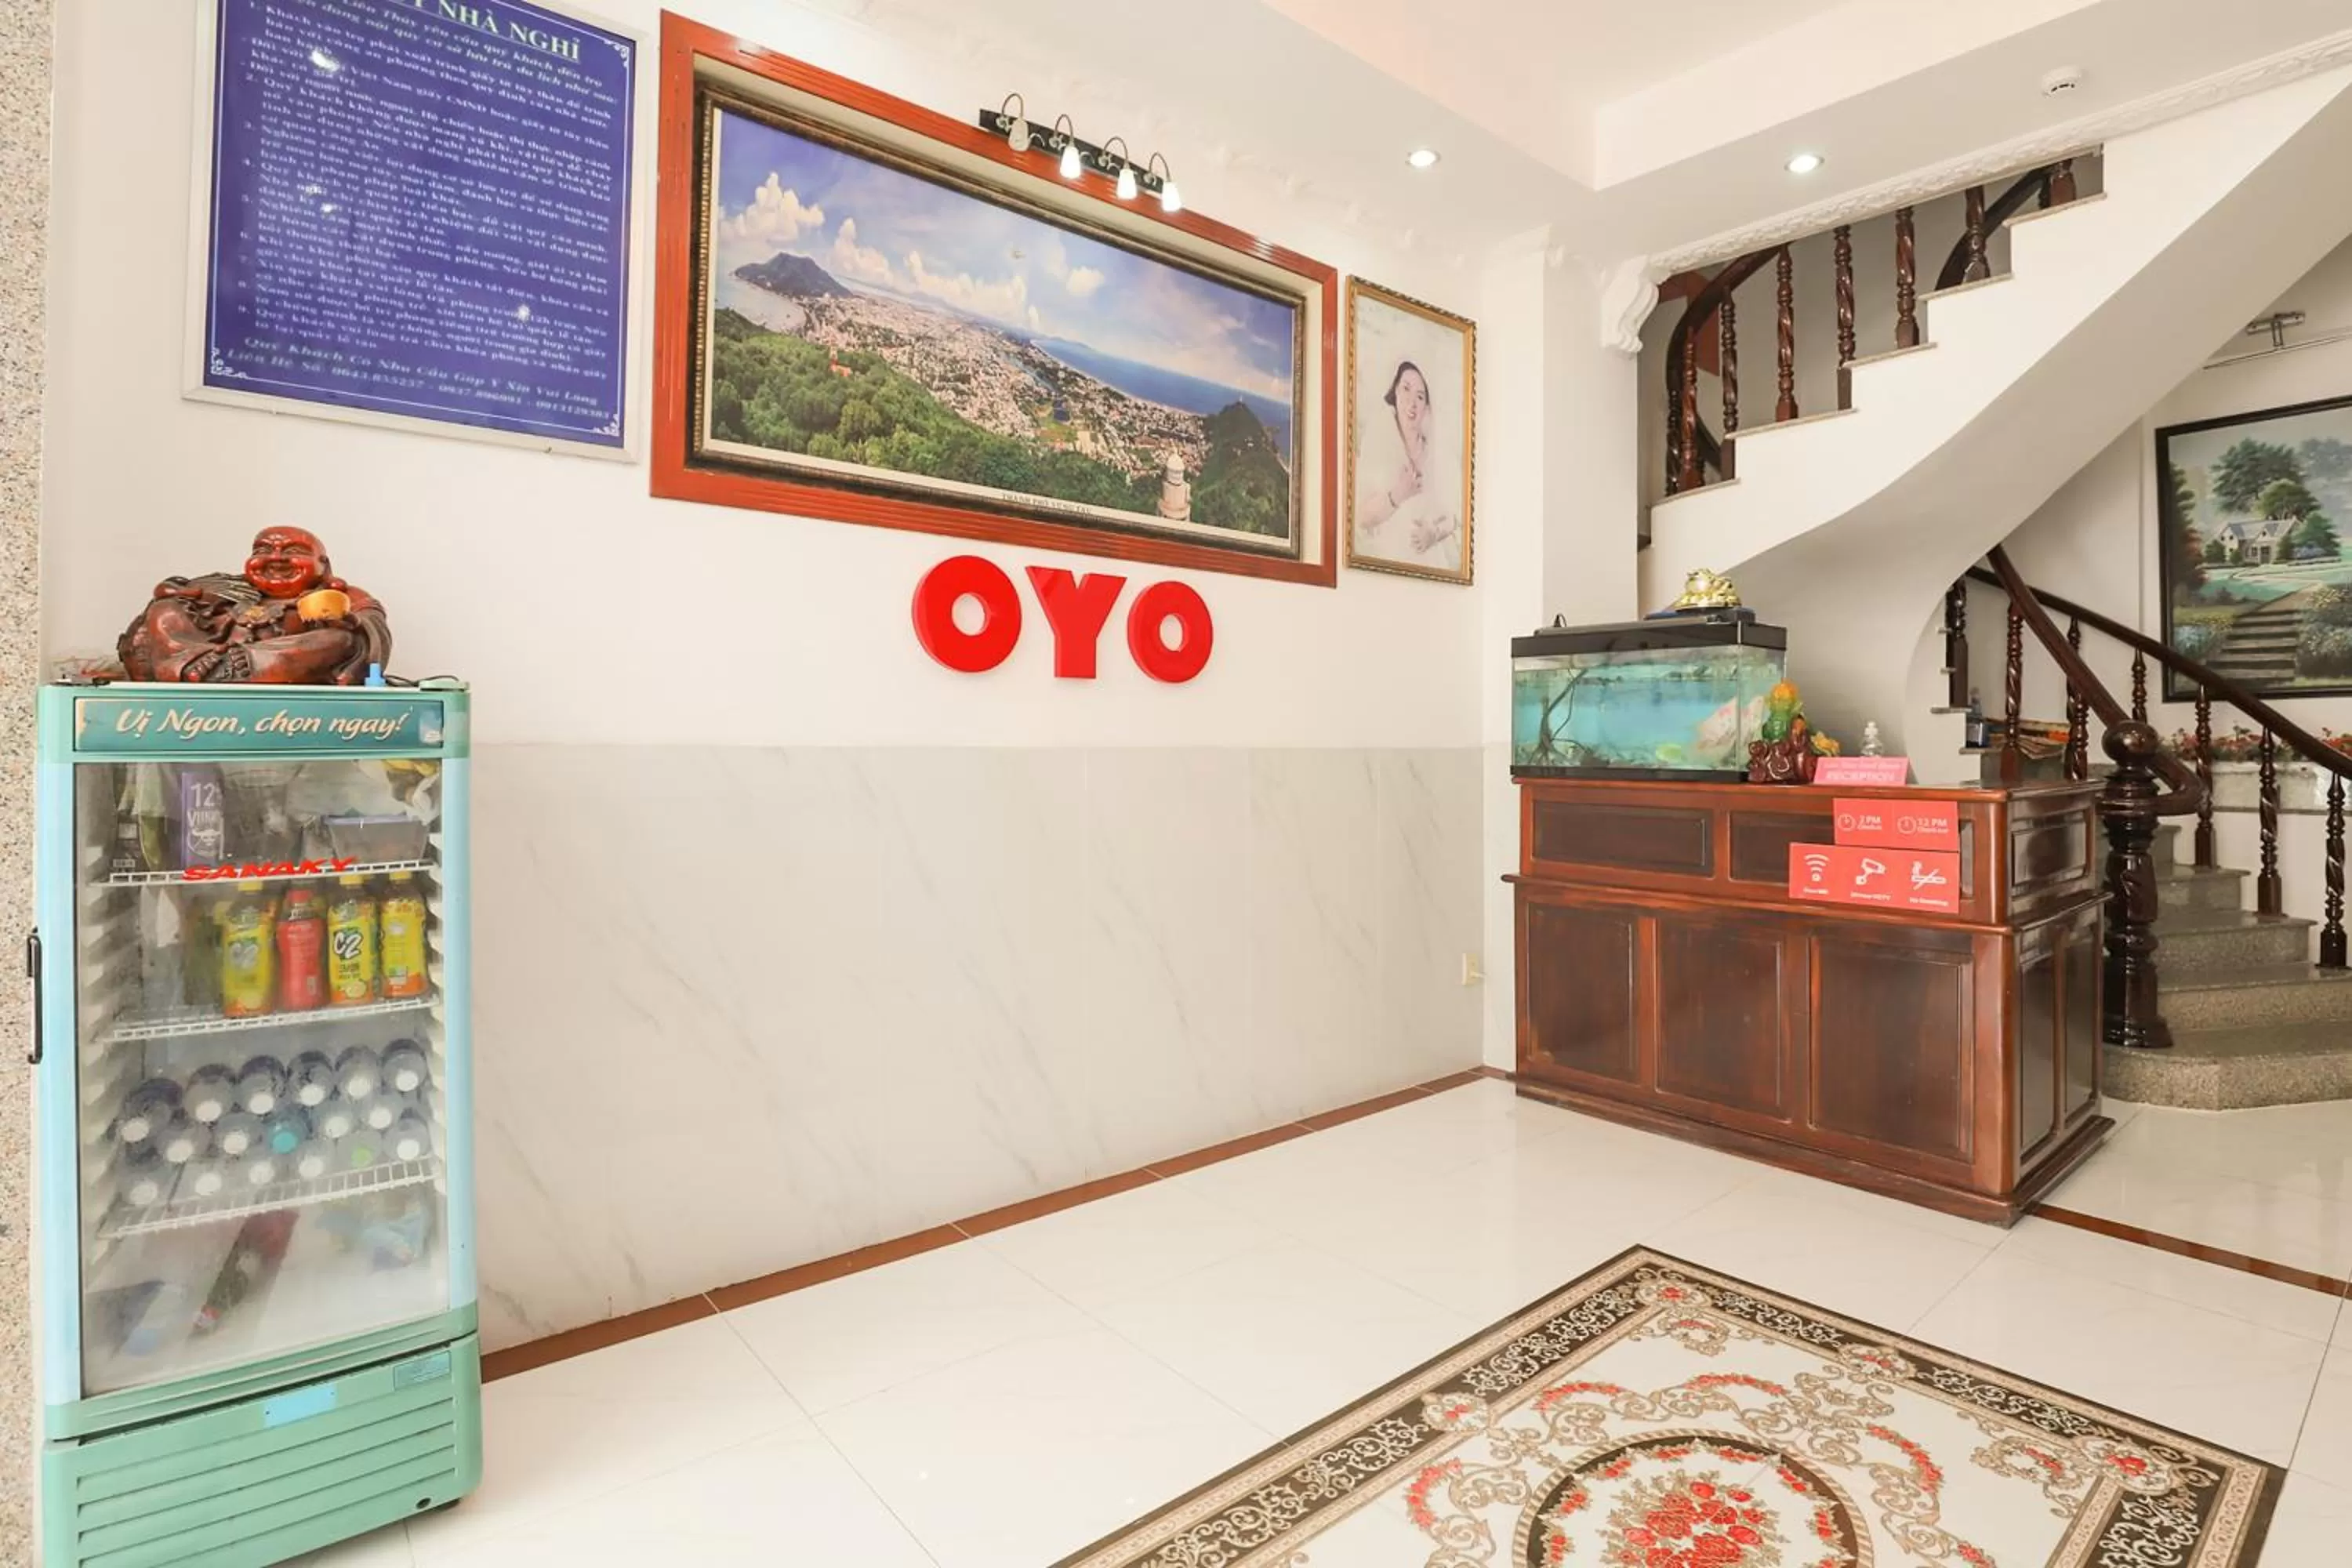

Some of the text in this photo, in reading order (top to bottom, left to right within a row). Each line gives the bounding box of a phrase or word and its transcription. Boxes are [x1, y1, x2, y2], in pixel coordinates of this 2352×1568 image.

[438, 0, 581, 60] NHÀ NGHỈ
[912, 555, 1214, 684] OYO
[117, 706, 413, 740] Vị Ngon, chọn ngay!
[182, 856, 357, 880] SANAKY
[334, 931, 362, 959] C2
